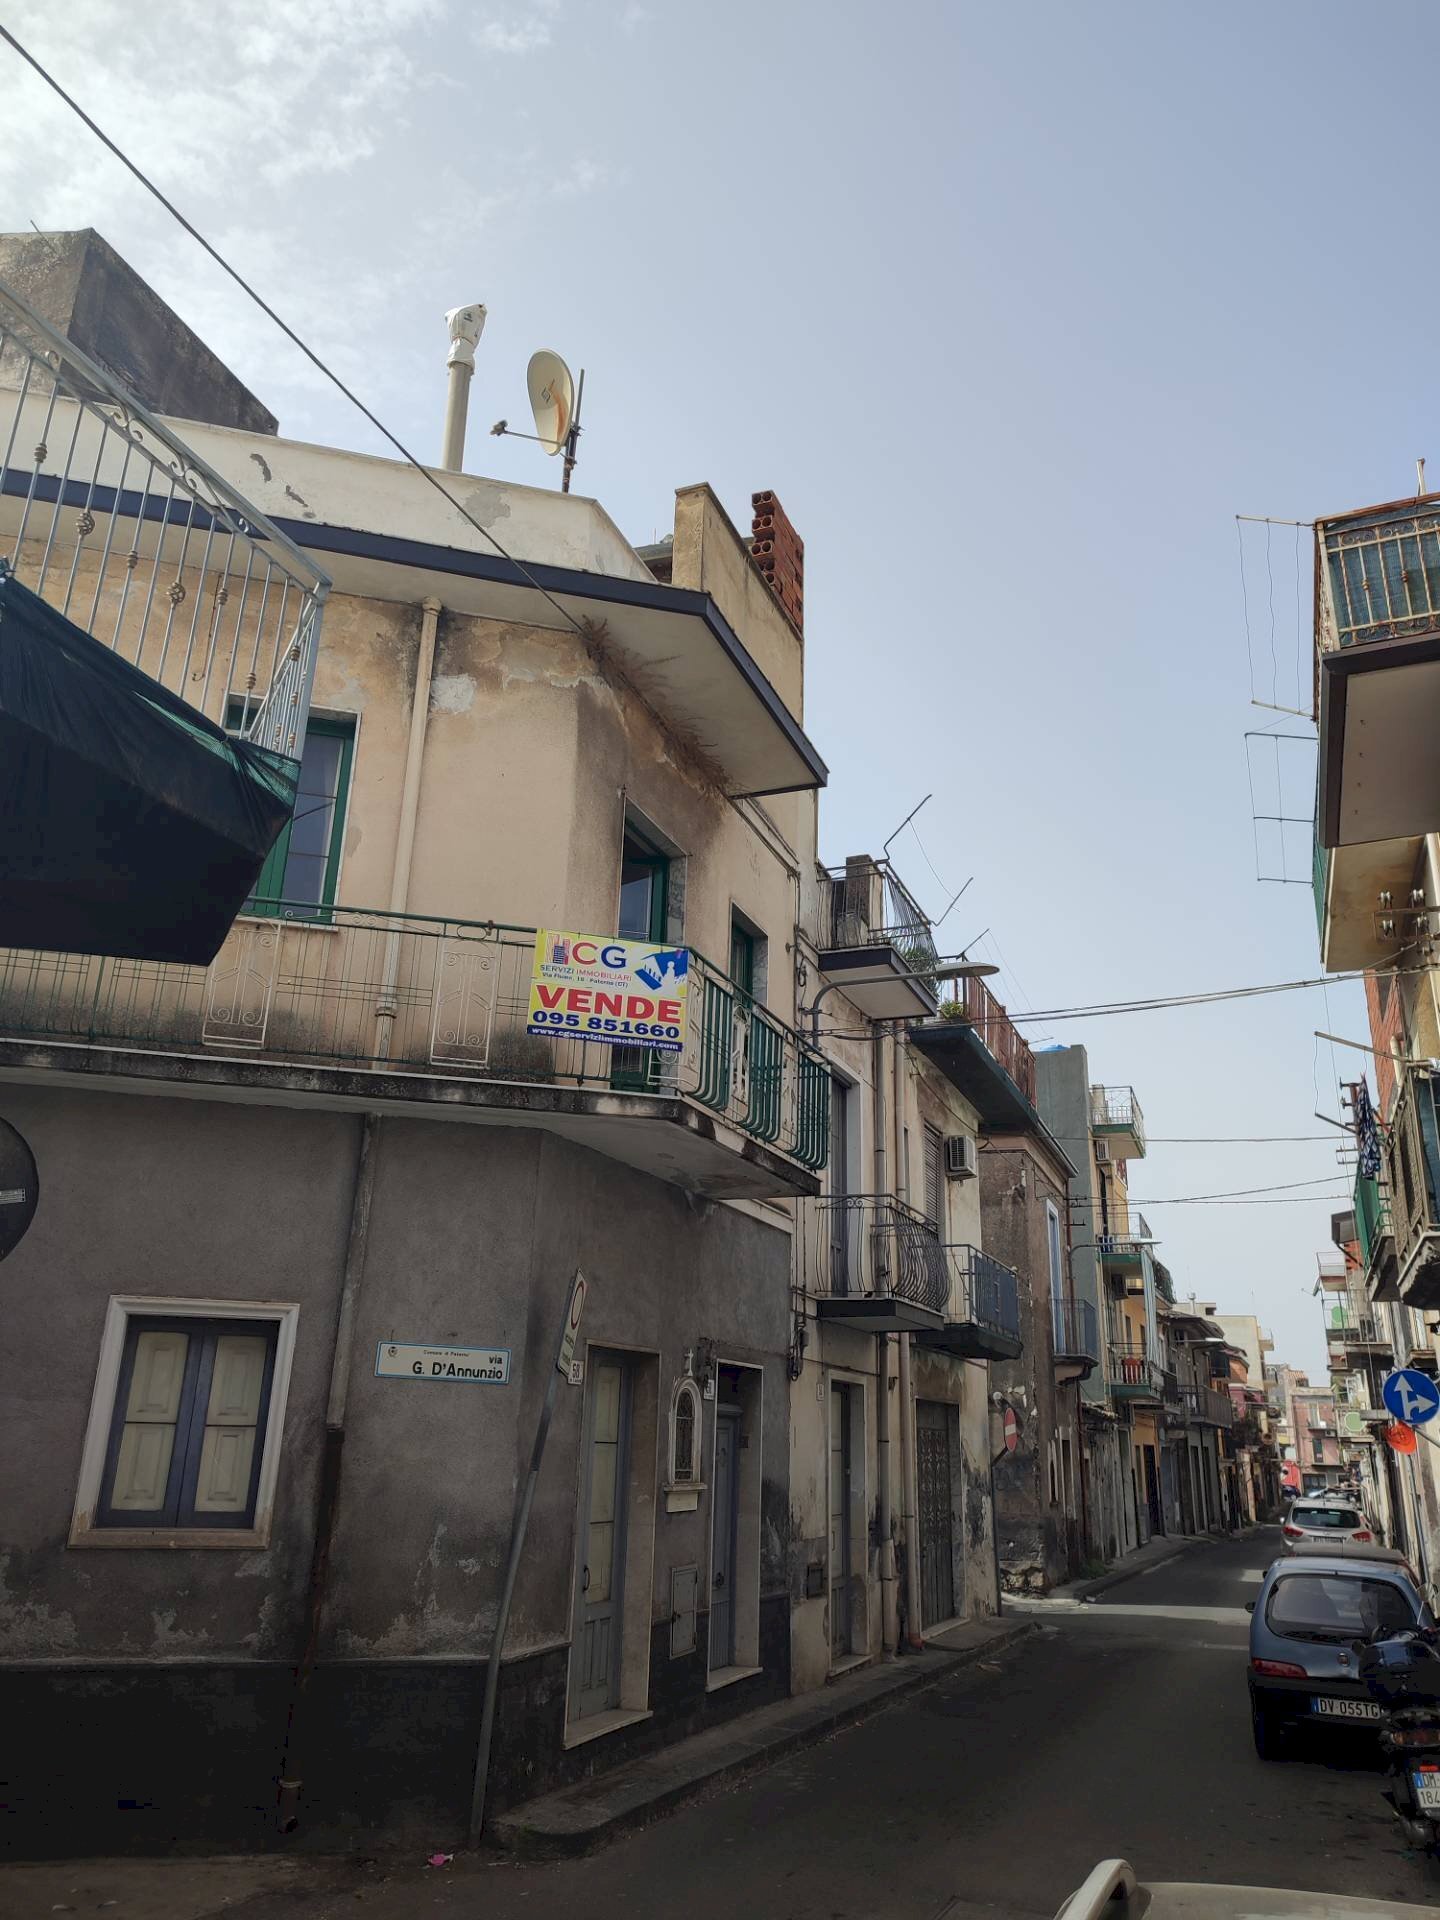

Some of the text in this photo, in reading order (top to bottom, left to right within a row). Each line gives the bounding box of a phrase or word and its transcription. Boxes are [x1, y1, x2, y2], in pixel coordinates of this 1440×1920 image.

[540, 964, 632, 982] SERVIZI IMMOBILIARI
[536, 984, 682, 1024] VENDE
[532, 1010, 680, 1038] 095 851660
[531, 1026, 679, 1050] www.cgserviziimmobiliari.com
[488, 1354, 503, 1365] via
[412, 1360, 503, 1380] G. D'Annunzio
[1320, 1699, 1335, 1713] DV
[1423, 1772, 1437, 1788] DM
